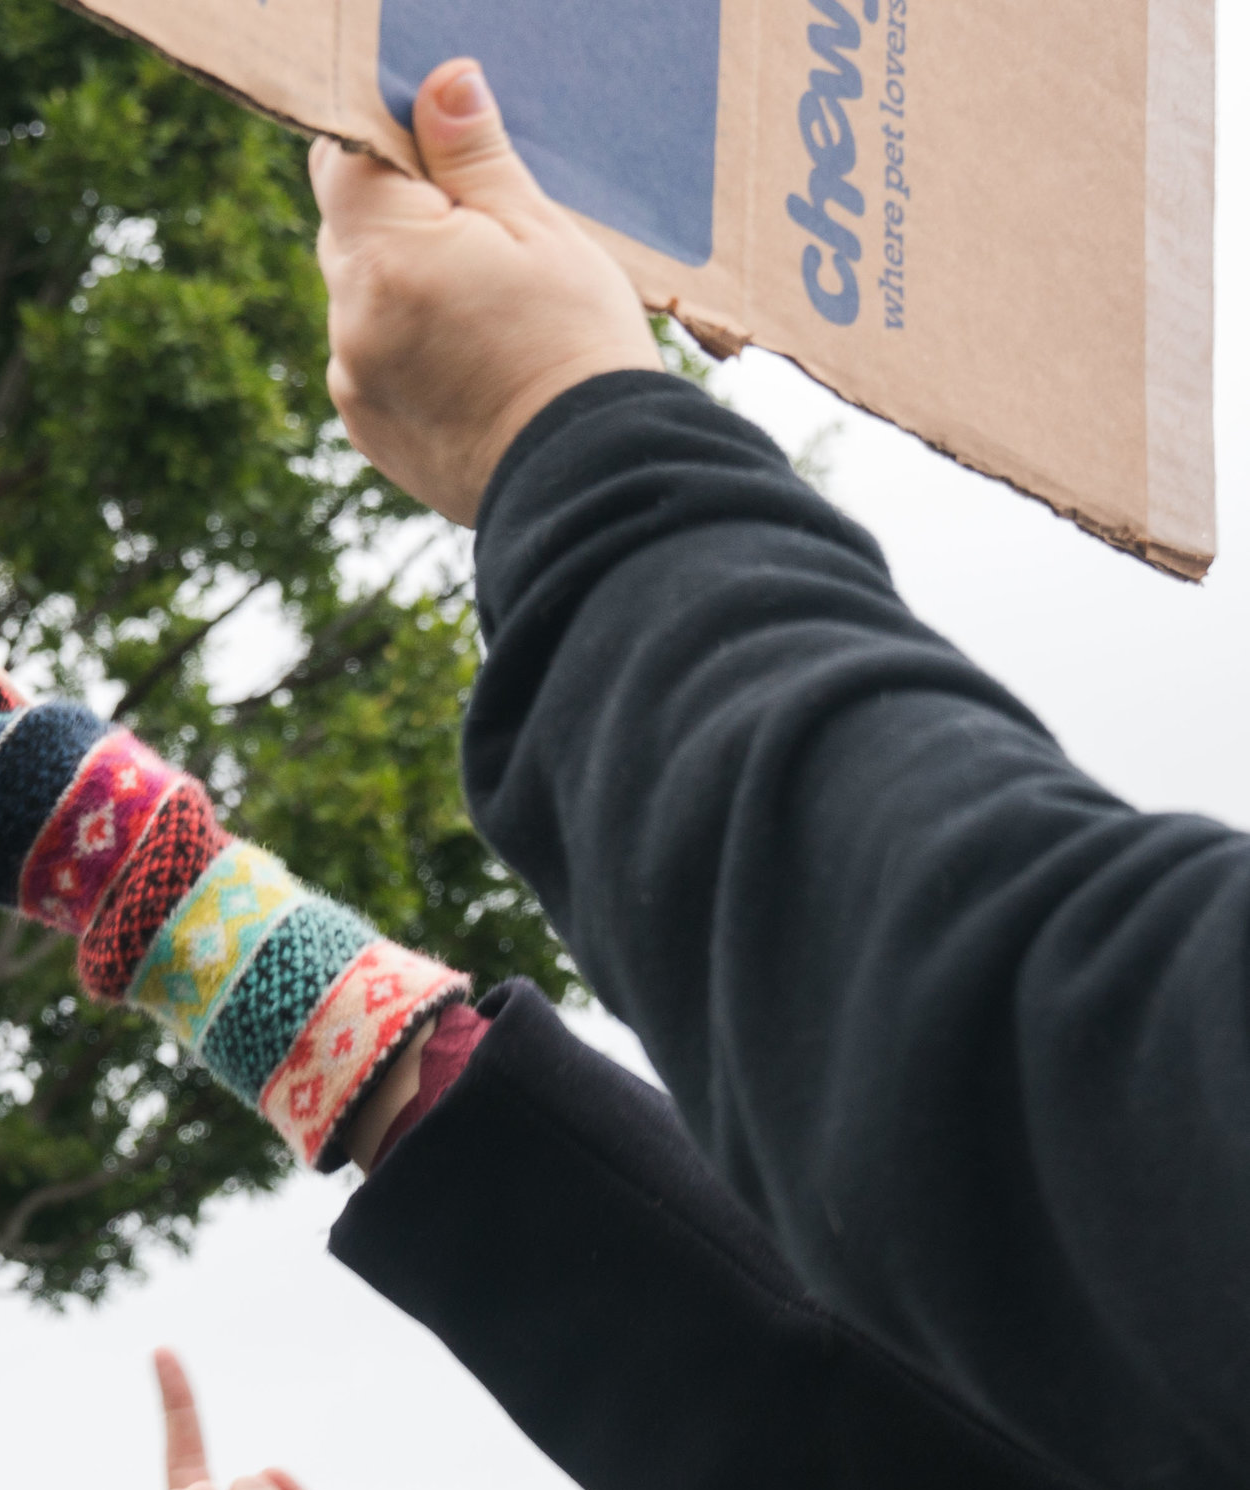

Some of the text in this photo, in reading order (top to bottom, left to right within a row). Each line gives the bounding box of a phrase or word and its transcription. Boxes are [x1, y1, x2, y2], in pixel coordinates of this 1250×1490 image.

[786, 0, 879, 327] chew
[881, 123, 910, 200] pet
[878, 200, 905, 330] where
